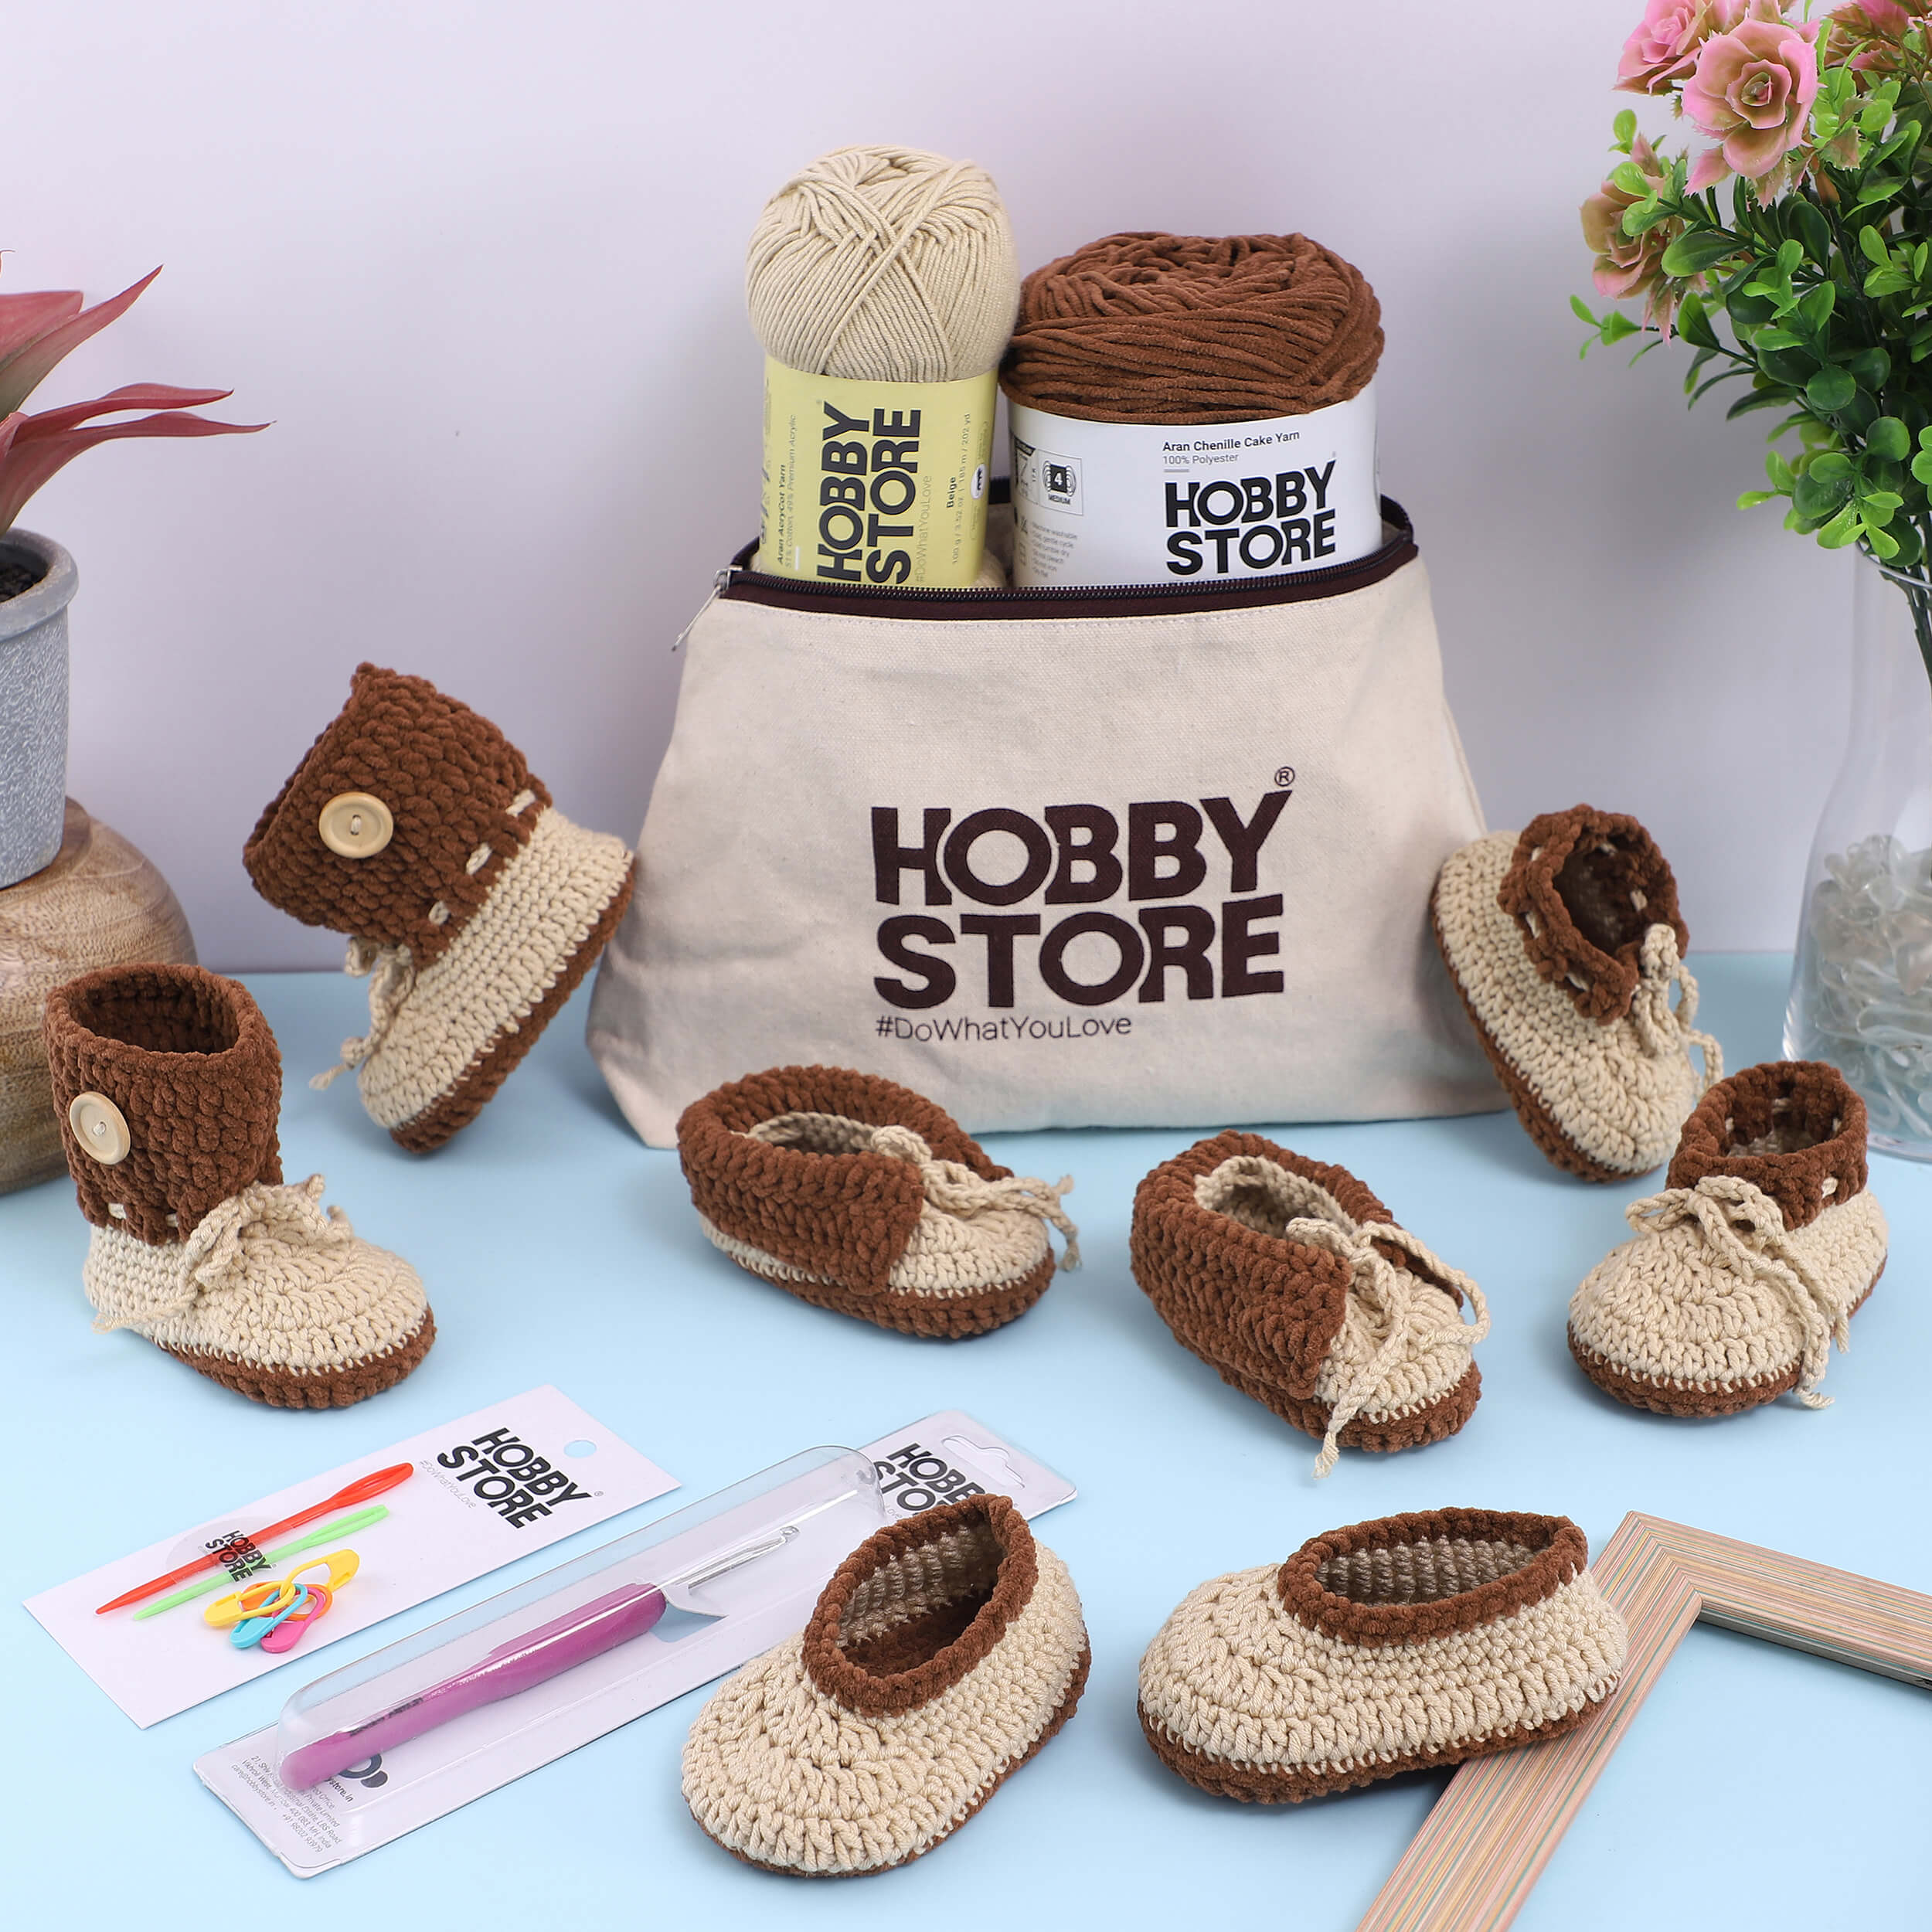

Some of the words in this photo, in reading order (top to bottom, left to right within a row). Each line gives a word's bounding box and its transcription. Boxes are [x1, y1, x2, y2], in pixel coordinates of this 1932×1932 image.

[1162, 441, 1190, 451] Aran
[1193, 438, 1241, 451] Chenille
[1244, 434, 1273, 447] Cake
[1275, 430, 1300, 443] Yarn
[1163, 455, 1190, 464] 100%
[1192, 454, 1239, 466] Polyester
[817, 400, 870, 582] HOBBY
[866, 407, 921, 585] STORE
[946, 476, 957, 509] Beige
[1054, 470, 1063, 485] 4
[1165, 458, 1337, 527] HOBBY
[915, 475, 932, 583] #DoWhatYouLove
[1166, 509, 1336, 576] STORE
[871, 789, 1292, 906] HOBBY
[874, 894, 1284, 1009] STORE
[875, 1015, 1131, 1043] #DoWhatYouLove
[437, 1445, 553, 1529] STORE
[471, 1427, 593, 1507] HOBBY
[870, 1460, 949, 1515] STO
[886, 1442, 985, 1505] HOBB
[205, 1538, 253, 1583] STORE
[223, 1530, 272, 1572] HOBBY
